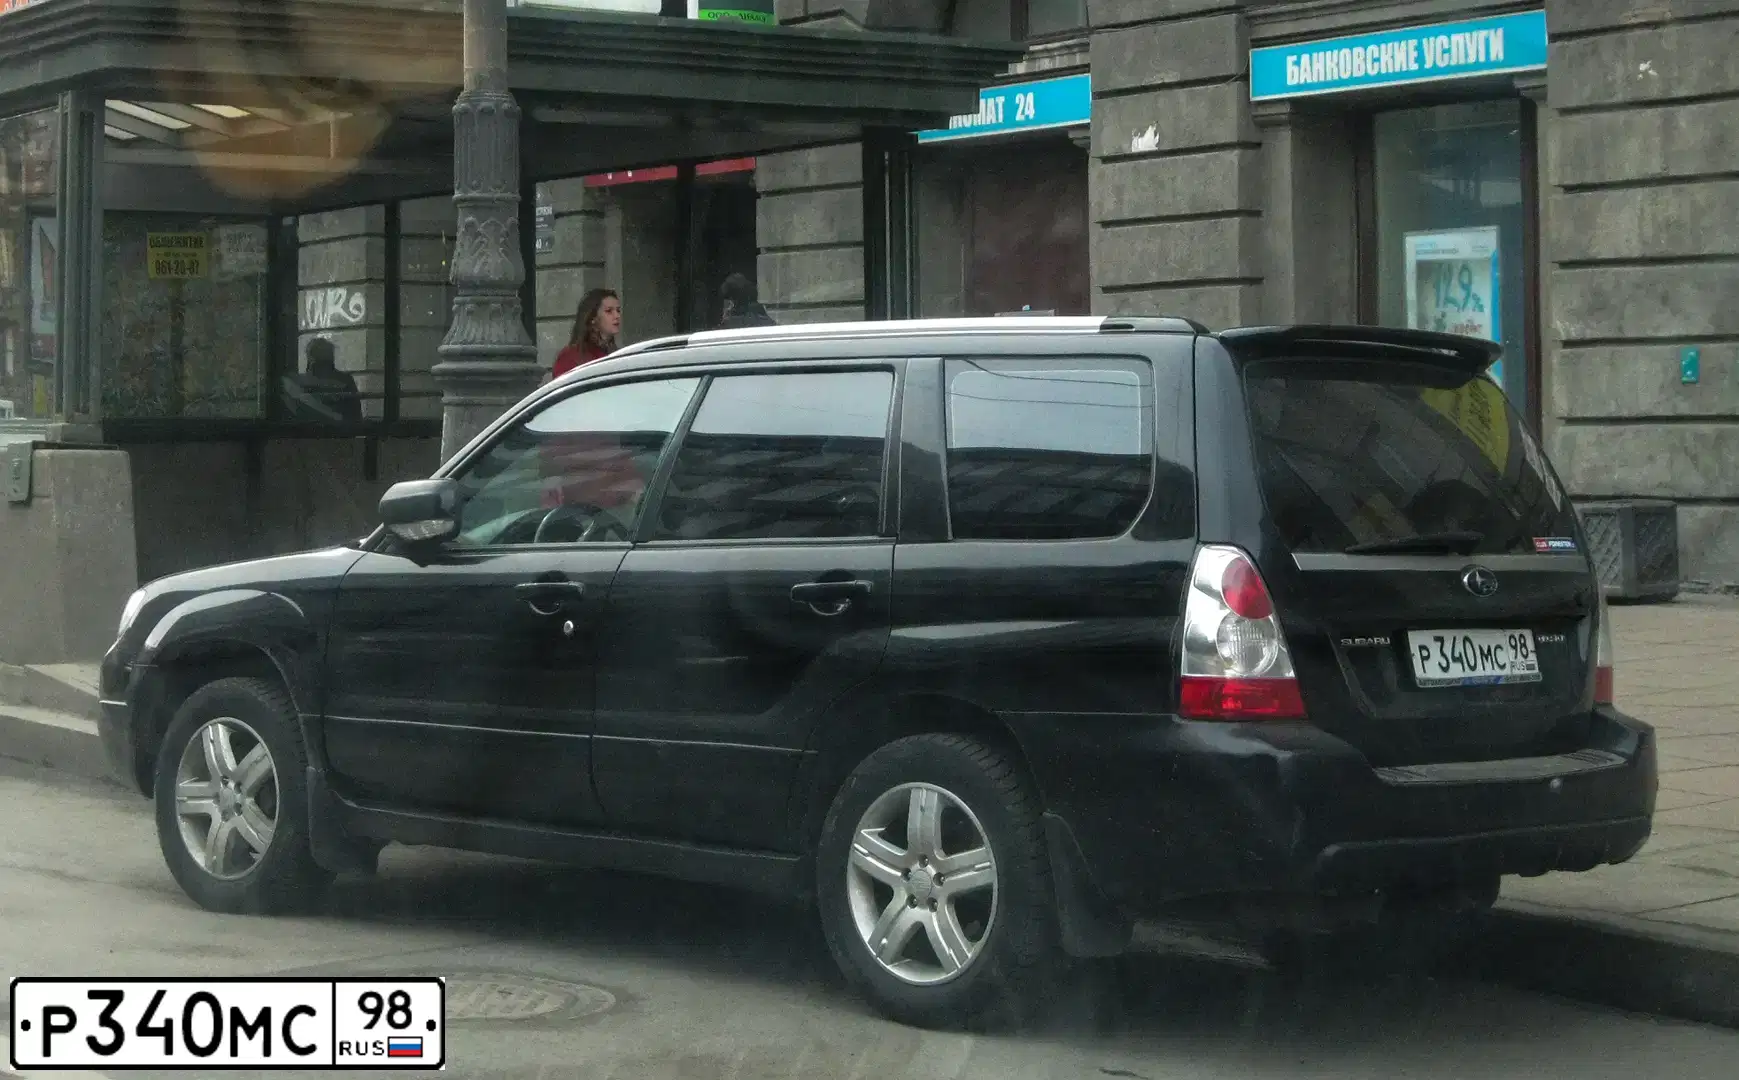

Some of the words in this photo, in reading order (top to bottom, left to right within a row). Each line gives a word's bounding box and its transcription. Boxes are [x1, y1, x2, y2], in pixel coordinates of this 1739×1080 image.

[1286, 38, 1419, 86] БАНКОВСКИЕ
[1422, 27, 1505, 70] УСЛУГИ
[1015, 91, 1036, 121] 24
[1340, 636, 1391, 646] SUBARU
[1508, 633, 1529, 660] 98
